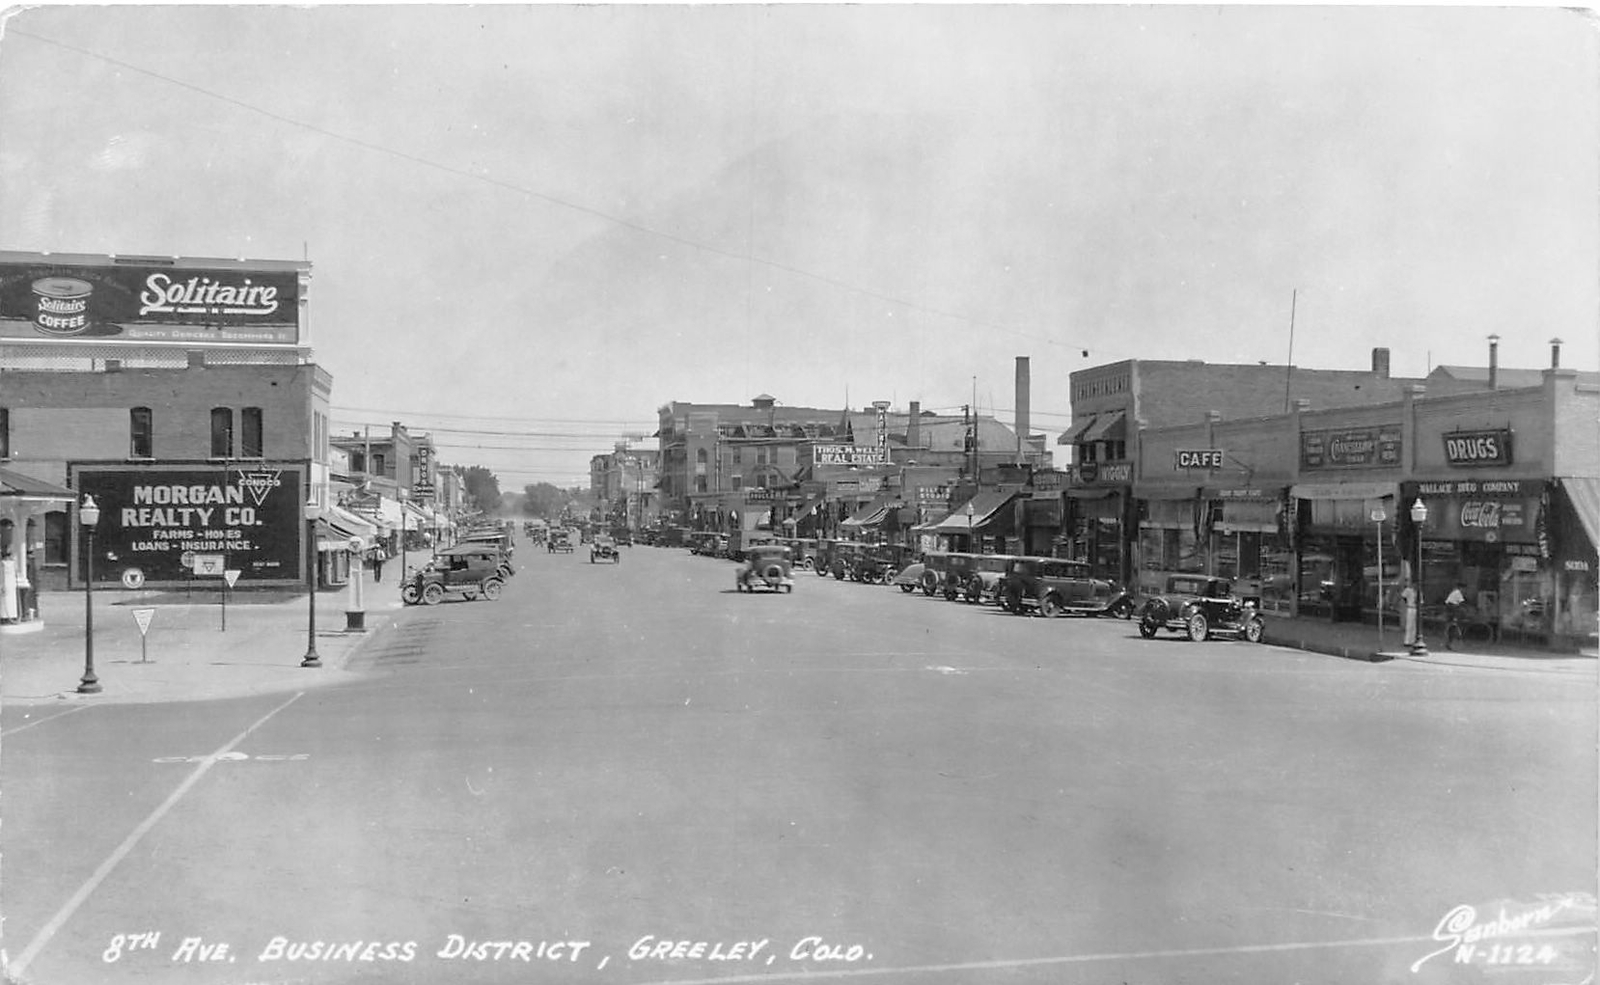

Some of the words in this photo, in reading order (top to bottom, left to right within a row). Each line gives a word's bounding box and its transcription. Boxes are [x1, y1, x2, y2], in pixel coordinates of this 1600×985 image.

[140, 274, 278, 315] Solitaire
[38, 297, 86, 311] Solitaire
[38, 315, 84, 329] COFFEE
[1447, 438, 1498, 460] DRUGS
[821, 454, 848, 463] REAL
[851, 454, 876, 463] ESTAT
[1180, 452, 1222, 467] CAFE
[238, 479, 281, 487] CONOCO
[1483, 482, 1521, 493] COMPANY
[134, 485, 243, 504] MORGAN
[121, 508, 214, 527] REALTY
[225, 508, 263, 527] CO.
[153, 529, 193, 539] FARMS
[132, 541, 169, 551] LOANS
